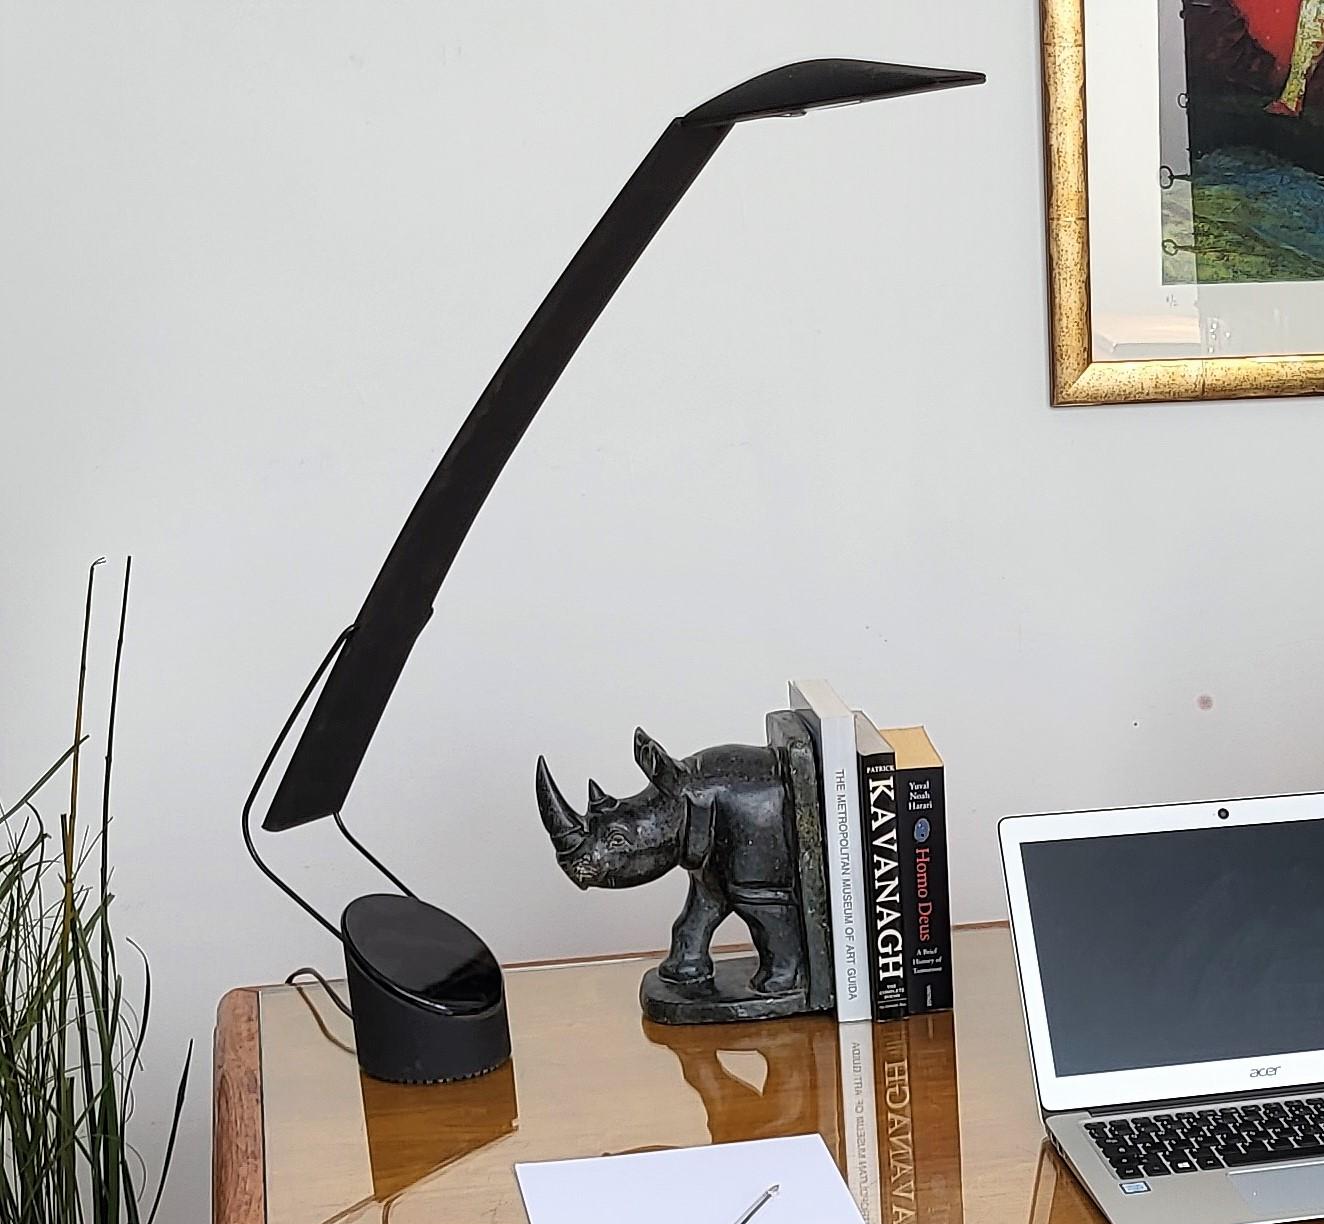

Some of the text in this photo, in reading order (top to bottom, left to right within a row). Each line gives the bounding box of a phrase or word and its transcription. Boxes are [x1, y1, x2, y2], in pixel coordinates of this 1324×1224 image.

[866, 764, 895, 774] PATRICK
[908, 780, 930, 791] Yuval
[909, 790, 931, 801] Noah
[908, 800, 933, 811] Harari
[834, 768, 858, 1001] THE METROPOLITAN MUSEUM OF ART GUIDA
[869, 775, 904, 982] KAVANAGH
[916, 847, 933, 942] Homo Deus
[1249, 1065, 1282, 1078] acer
